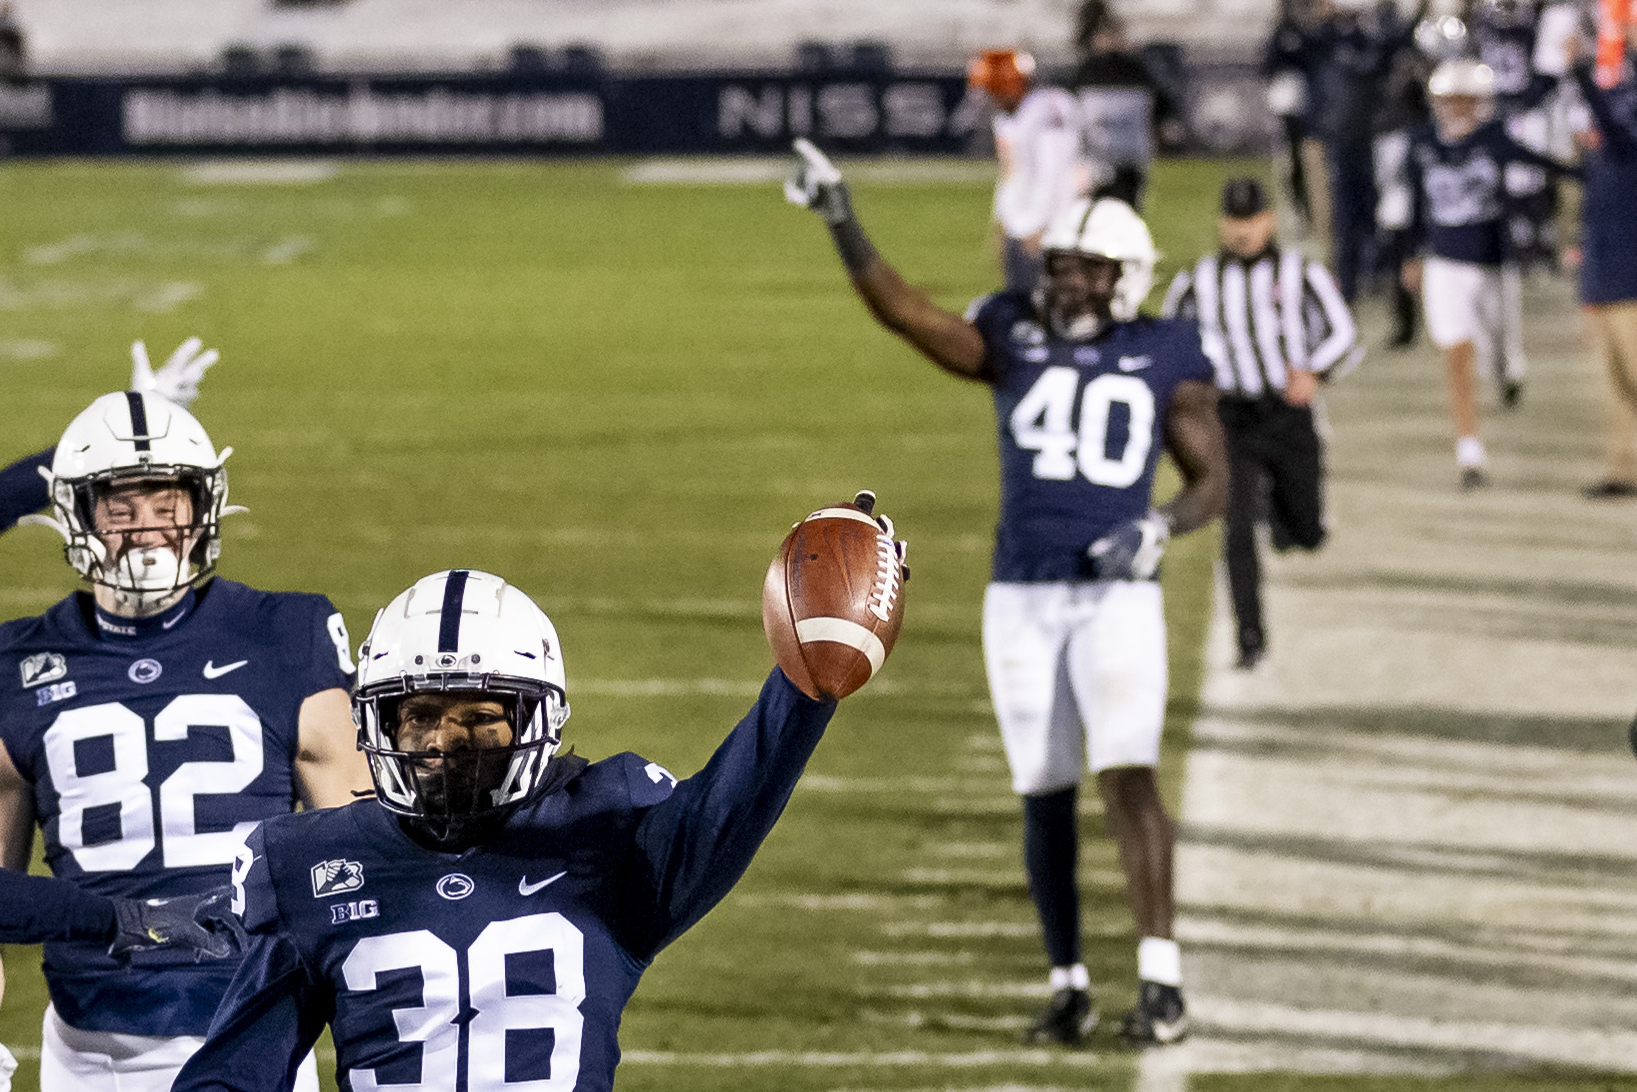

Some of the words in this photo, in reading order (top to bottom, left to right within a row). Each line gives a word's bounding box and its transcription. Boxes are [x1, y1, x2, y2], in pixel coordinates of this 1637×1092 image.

[1010, 365, 1156, 488] 40
[43, 693, 264, 872] 82
[330, 899, 380, 924] BIG
